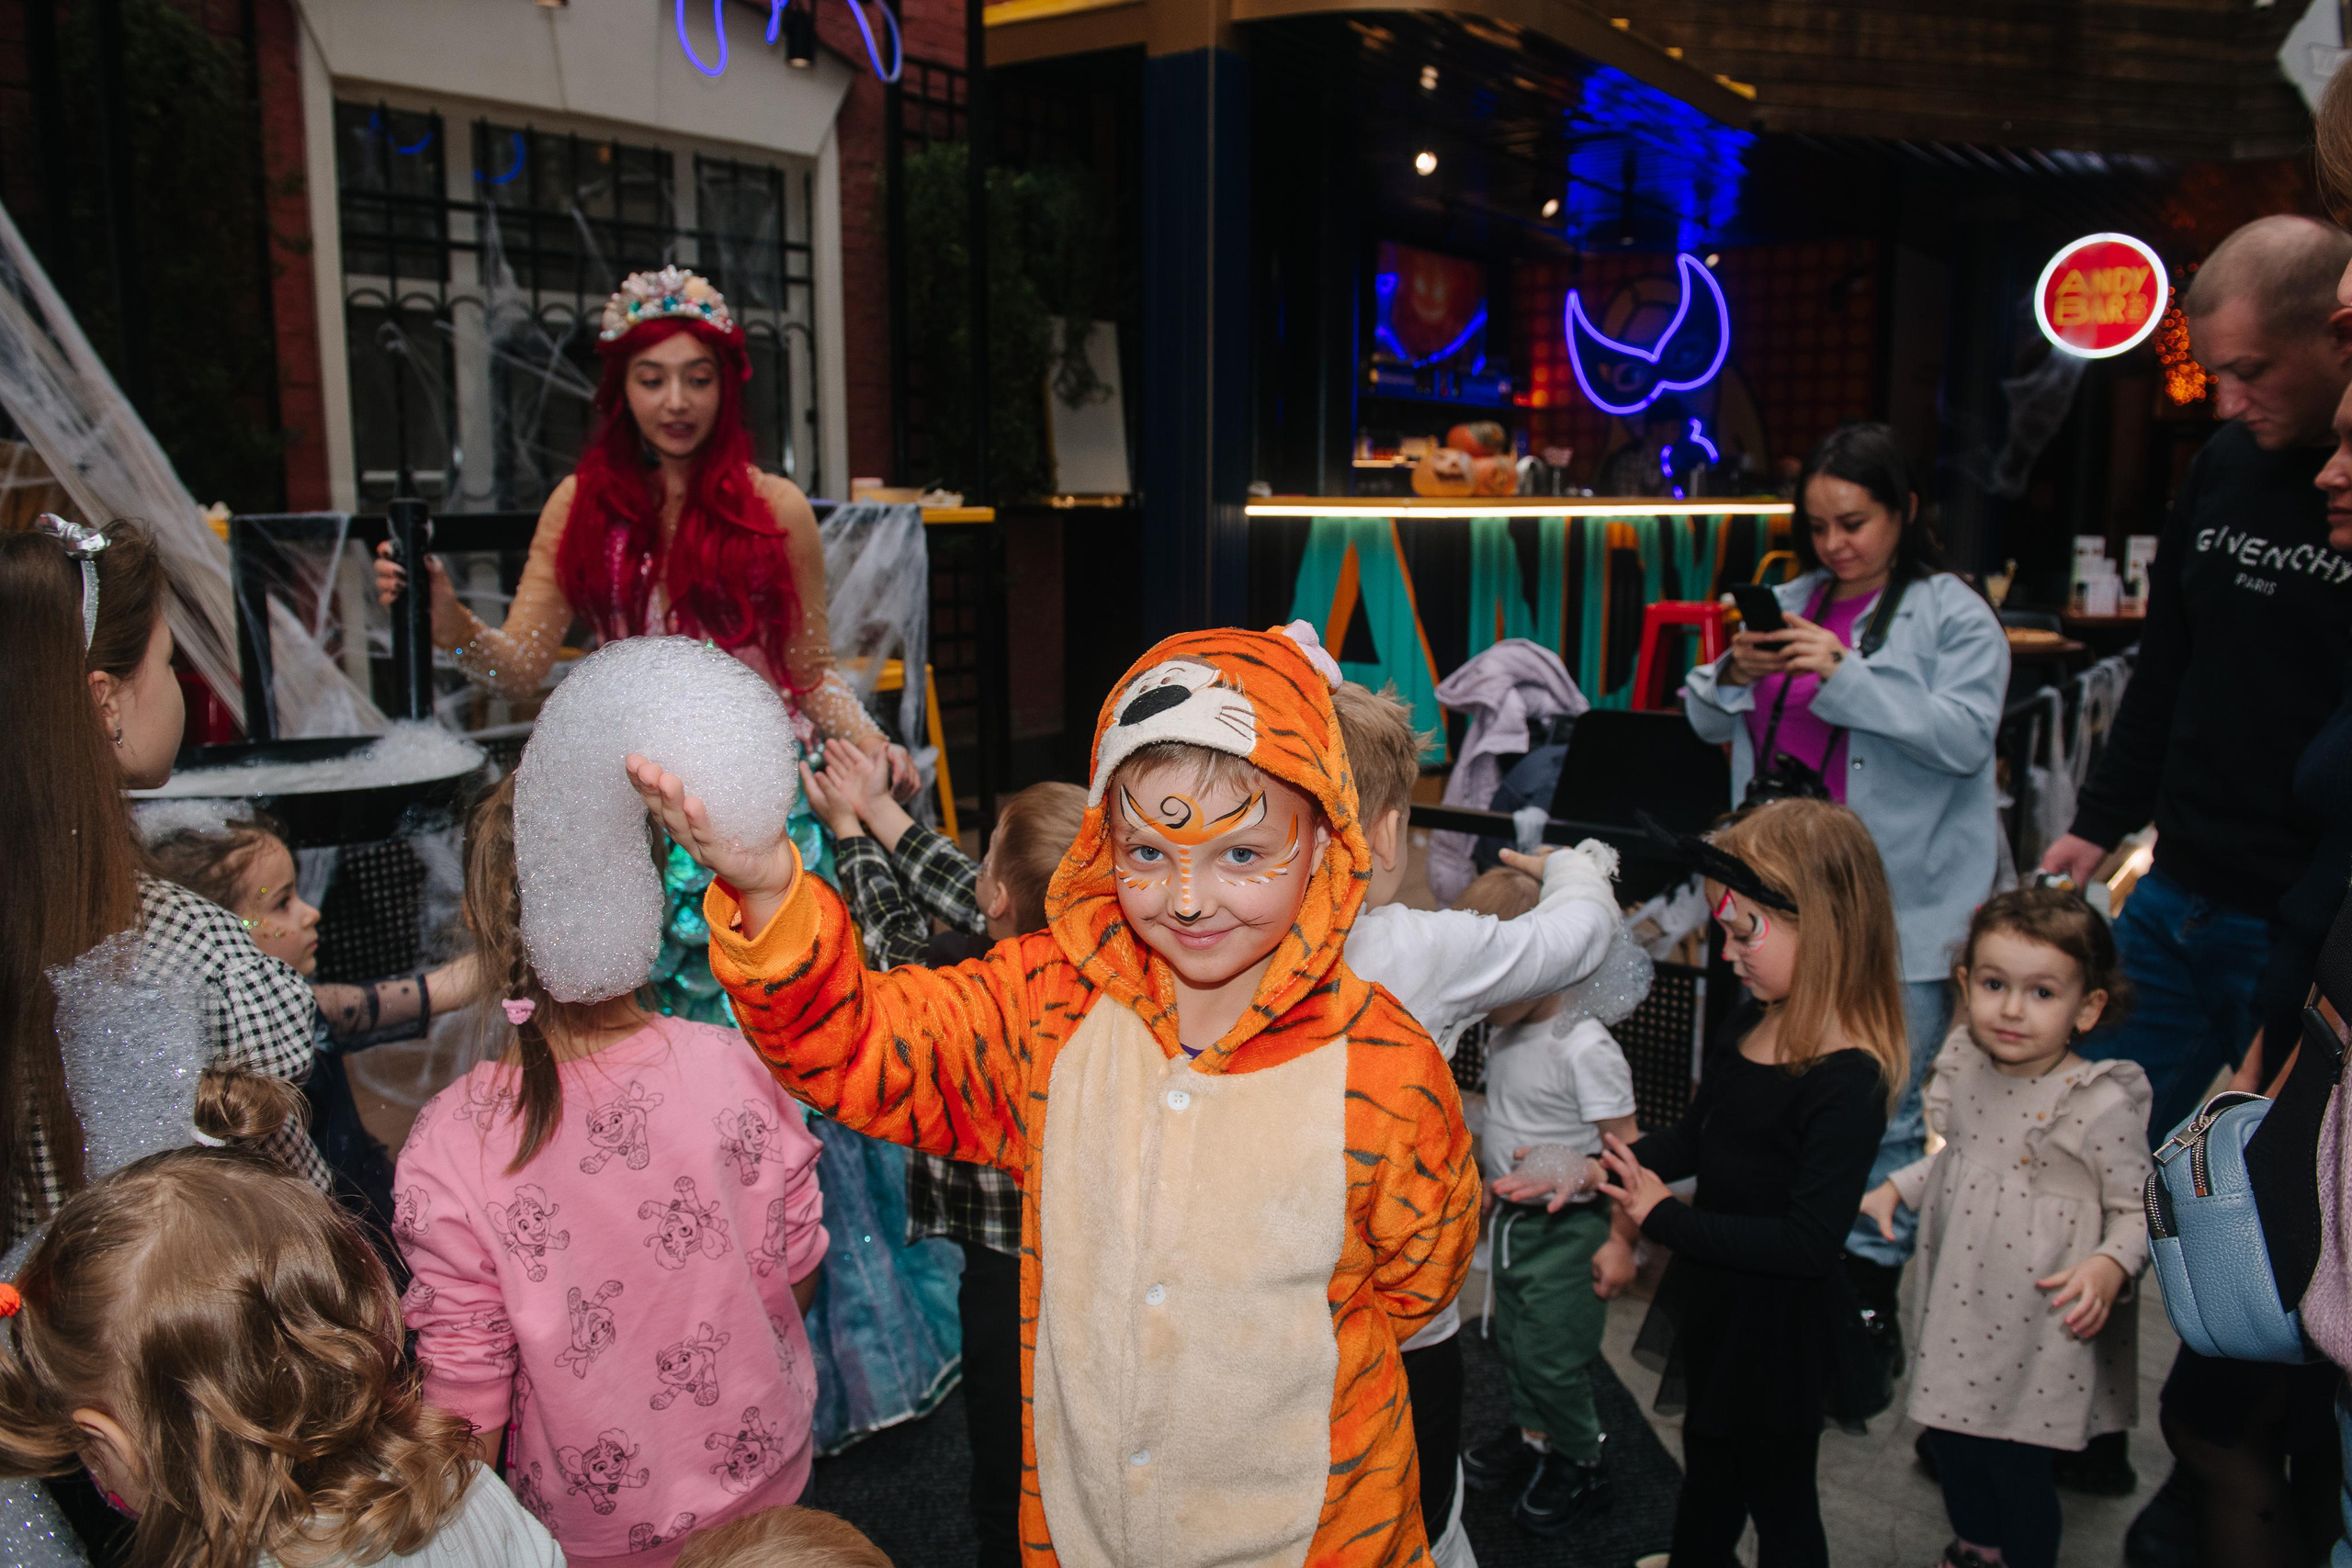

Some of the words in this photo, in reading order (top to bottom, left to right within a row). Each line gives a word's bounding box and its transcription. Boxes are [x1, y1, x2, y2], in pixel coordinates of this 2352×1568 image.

[2054, 265, 2151, 297] ANDY
[2196, 525, 2352, 584] GIVENCHY
[2233, 571, 2278, 596] PARIS
[1286, 516, 1731, 762] ANDY
